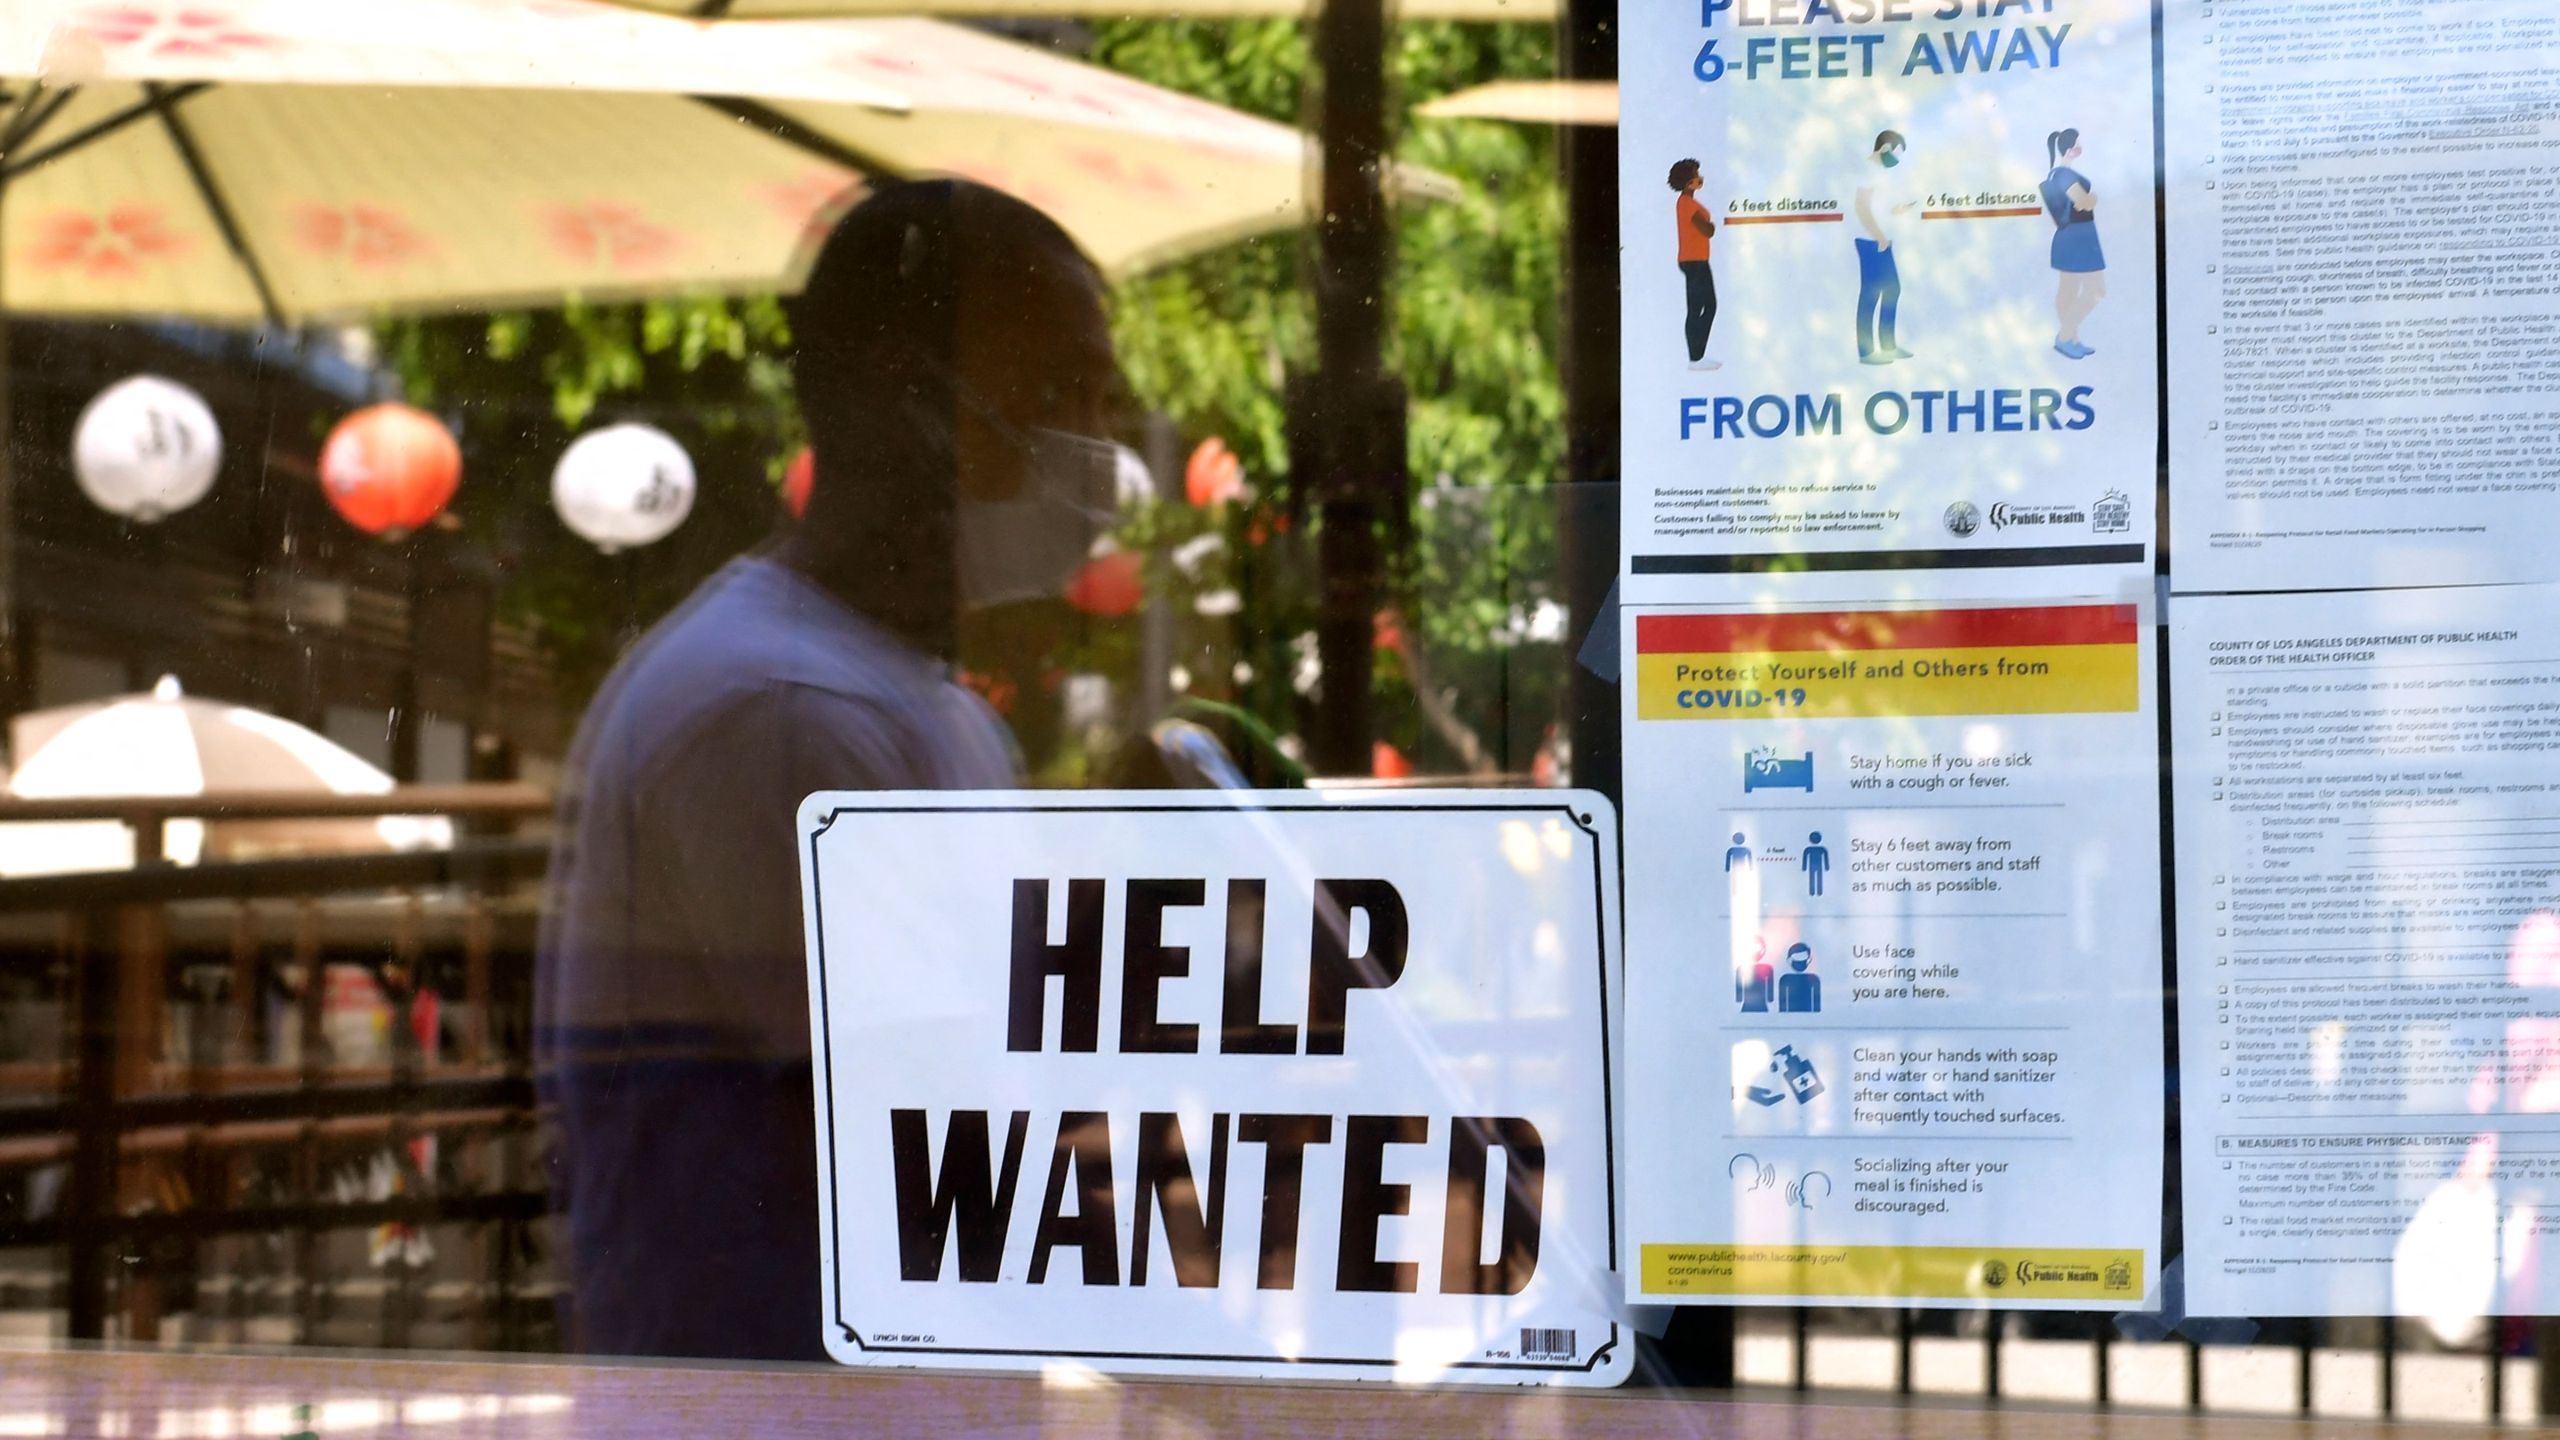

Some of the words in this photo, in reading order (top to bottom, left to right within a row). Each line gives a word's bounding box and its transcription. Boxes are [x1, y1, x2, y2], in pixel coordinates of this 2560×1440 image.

[1694, 35, 1884, 82] 6-FEET
[1901, 24, 2073, 76] AWAY
[1729, 200, 1738, 212] 6
[1742, 199, 1772, 212] feet
[1777, 198, 1838, 211] distance
[1927, 195, 1936, 207] 6
[1940, 193, 1971, 207] feet
[1975, 192, 2036, 205] distance
[1680, 393, 1842, 441] FROM
[1865, 385, 2095, 436] OTHERS
[1654, 488, 1704, 496] Businesses
[1706, 487, 1745, 495] maintain
[1747, 486, 1762, 494] the
[1764, 484, 1786, 496] right
[1788, 485, 1798, 493] to
[1800, 483, 1829, 492] refuse
[1832, 483, 1864, 492] service
[1654, 499, 1719, 509] non-compliant
[1721, 499, 1770, 507] customers.
[1654, 515, 1704, 523] Customers
[1706, 514, 1734, 524] failing
[1737, 514, 1747, 522] to
[1749, 513, 1782, 523] comply
[1784, 514, 1803, 522] may
[1805, 512, 1817, 520] be
[1819, 512, 1846, 520] asked
[1861, 511, 1886, 519] leave
[1888, 510, 1900, 520] by
[2010, 513, 2045, 525] Public
[2049, 511, 2085, 524] Health
[1654, 527, 1714, 537] management
[1717, 523, 1748, 534] and/or
[1750, 524, 1790, 534] reported
[1792, 524, 1802, 532] to
[1804, 524, 1821, 532] law
[1823, 522, 1884, 532] enforcement.
[2209, 641, 2254, 651] COUNTY
[2256, 640, 2270, 650] OF
[2273, 639, 2293, 650] LOS
[2295, 638, 2343, 648] ANGELES
[2345, 635, 2418, 647] DEPARTMENT
[2420, 634, 2434, 644] OF
[2437, 632, 2474, 643] PUBLIC
[2477, 631, 2518, 641] HEALTH
[2209, 656, 2247, 666] ORDER
[2249, 655, 2263, 664] OF
[2266, 654, 2285, 664] THE
[2289, 653, 2330, 663] HEALTH
[2332, 651, 2375, 662] OFFICER
[1677, 663, 1759, 682] Protect
[1769, 661, 1857, 680] Yourself
[1864, 660, 1904, 679] and
[1913, 659, 1989, 678] Others
[1997, 657, 2049, 675] from
[1677, 688, 1807, 708] COVID-19
[1850, 755, 1882, 772] Stay
[1886, 754, 1928, 768] home
[1932, 753, 1942, 767] if
[1946, 758, 1973, 771] you
[1978, 759, 2001, 768] are
[2005, 752, 2032, 767] sick
[1850, 775, 1881, 789] with
[1886, 779, 1894, 789] a
[1898, 774, 1945, 792] cough
[1949, 778, 1965, 788] or
[1969, 773, 2010, 787] fever.
[1851, 838, 1883, 856] Stay
[1887, 839, 1896, 851] 6
[1900, 837, 1930, 852] feet
[1935, 841, 1972, 855] away
[1976, 836, 2011, 851] from
[1851, 858, 1891, 872] other
[1896, 860, 1972, 872] customers
[1976, 856, 2004, 871] and
[2008, 856, 2040, 871] staff
[1852, 882, 1867, 892] as
[1872, 878, 1912, 892] much
[1916, 882, 1932, 892] as
[1936, 877, 2002, 895] possible.
[1853, 945, 1880, 958] Use
[1885, 944, 1915, 958] face
[1007, 878, 1409, 1055] HELP
[1853, 965, 1916, 982] covering
[1921, 964, 1959, 978] while
[1852, 988, 1880, 1002] you
[1884, 988, 1908, 998] are
[1912, 984, 1950, 998] here.
[1853, 1048, 1895, 1062] Clean
[1900, 1052, 1933, 1066] your
[1937, 1048, 1981, 1062] hands
[1986, 1048, 2017, 1062] with
[2022, 1052, 2058, 1066] soap
[1853, 1068, 1881, 1082] and
[1885, 1070, 1927, 1082] water
[1932, 1072, 1948, 1081] or
[1953, 1068, 1989, 1082] hand
[1994, 1068, 2056, 1082] sanitizer
[1854, 1087, 1889, 1102] after
[1893, 1091, 1948, 1102] contact
[1953, 1088, 1984, 1102] with
[1854, 1107, 1930, 1126] frequently
[1934, 1108, 1995, 1123] touched
[2000, 1108, 2065, 1123] surfaces.
[2238, 1138, 2298, 1148] MEASURES
[2301, 1138, 2316, 1147] TO
[2319, 1137, 2363, 1147] ENSURE
[2366, 1136, 2420, 1146] PHYSICAL
[1854, 1157, 1931, 1176] Socializing
[1936, 1157, 1971, 1172] after
[1976, 1163, 2009, 1176] your
[1854, 1178, 1889, 1192] meal
[1894, 1179, 1905, 1192] is
[1909, 1177, 1967, 1193] finished
[1972, 1179, 1983, 1193] is
[890, 1108, 1546, 1295] WANTED
[1854, 1197, 1949, 1216] discouraged.
[1667, 1265, 1733, 1276] coronavirus
[2033, 1271, 2064, 1281] Public
[2067, 1271, 2099, 1282] Health
[873, 1334, 898, 1342] LYNCH
